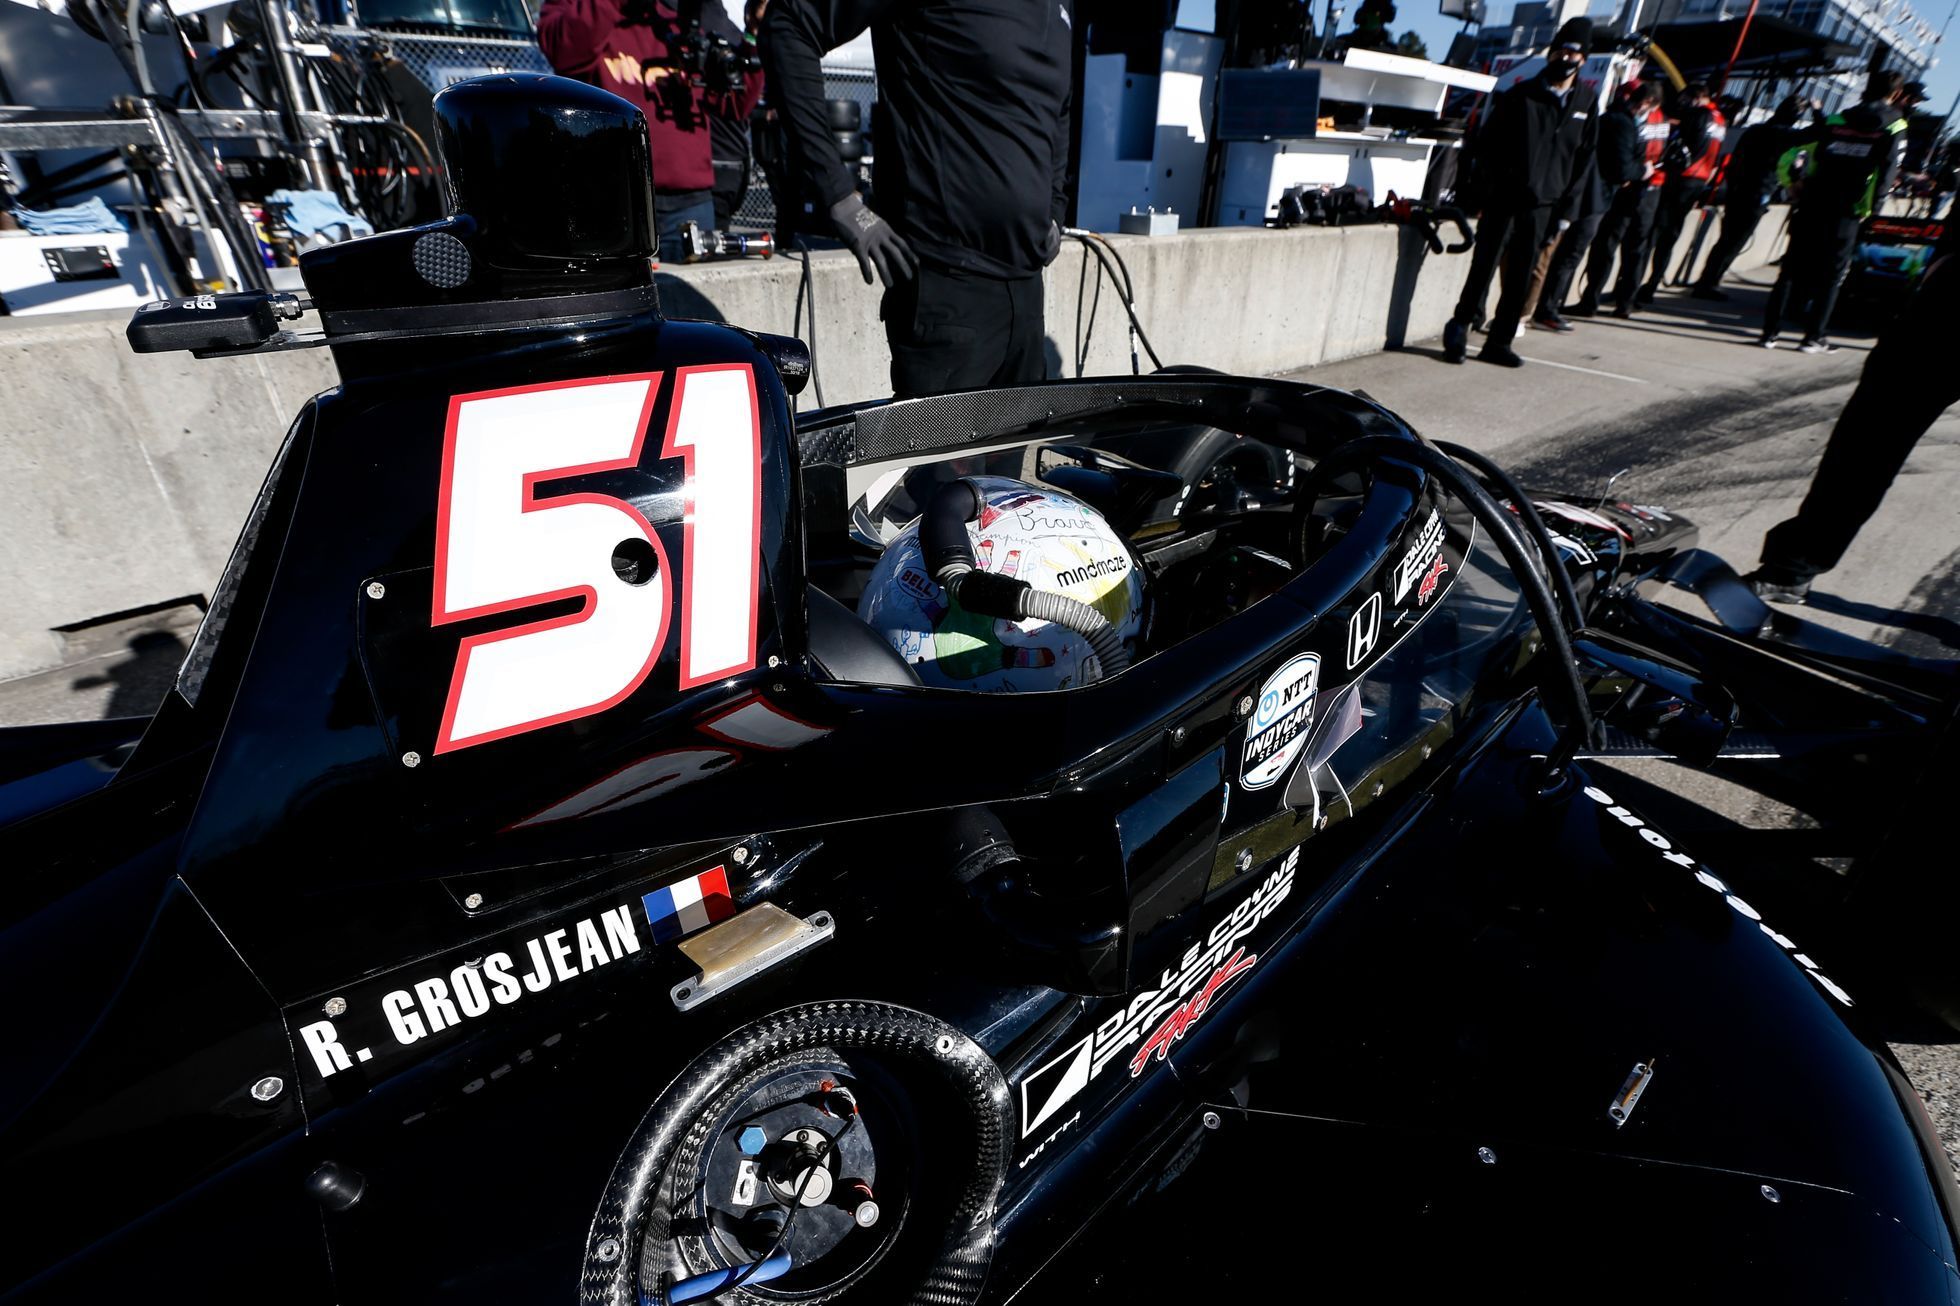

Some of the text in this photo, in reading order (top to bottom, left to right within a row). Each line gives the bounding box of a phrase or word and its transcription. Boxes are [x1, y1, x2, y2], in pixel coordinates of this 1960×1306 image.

[431, 363, 762, 756] 51
[1057, 555, 1127, 588] mindmaze
[1404, 531, 1426, 567] DALE
[901, 569, 933, 597] BELL
[1282, 671, 1313, 707] NTT
[1245, 698, 1314, 762] INDYCAR
[1258, 727, 1298, 762] SERIES
[1090, 868, 1296, 1080] RACING
[1096, 845, 1300, 1047] DALE COYNE
[299, 1020, 374, 1078] R.
[381, 903, 641, 1045] GROSJEAN
[1019, 1110, 1081, 1169] WITH
